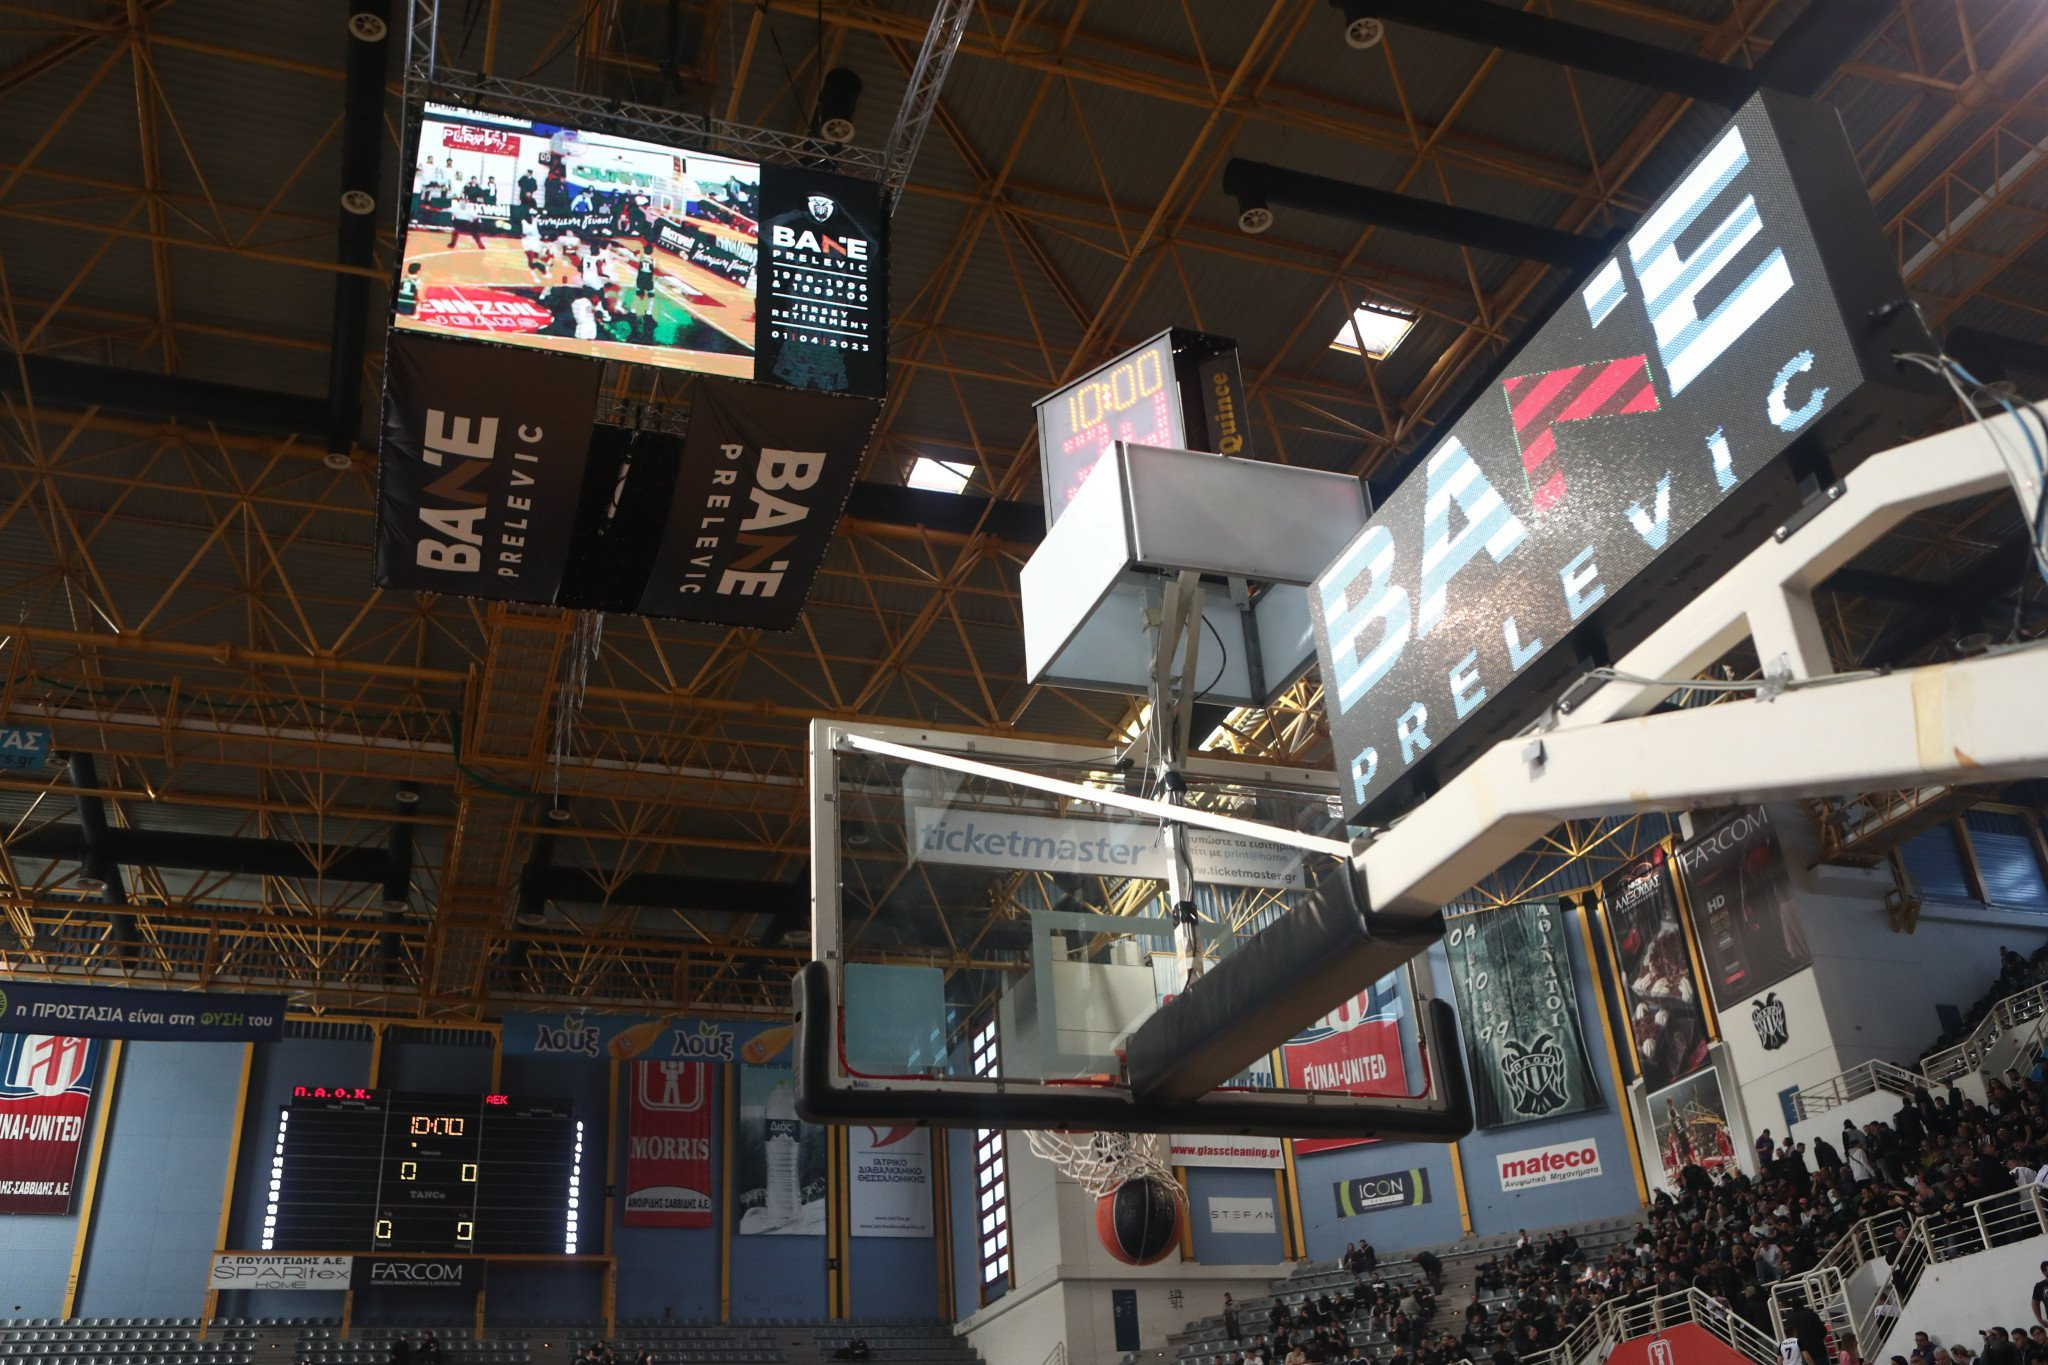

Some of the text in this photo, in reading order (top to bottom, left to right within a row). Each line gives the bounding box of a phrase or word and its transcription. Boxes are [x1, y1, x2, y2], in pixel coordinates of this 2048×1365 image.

[773, 250, 867, 273] PRELEVIC
[772, 280, 868, 302] & 1999-00
[773, 270, 867, 292] 1988-1996
[772, 309, 868, 330] RETIREMENT
[792, 303, 849, 318] JERSEY
[1069, 349, 1163, 432] 10:00
[1213, 372, 1243, 454] Quince
[498, 424, 543, 577] PRELEVIC
[679, 444, 744, 594] PRELEVIC
[1351, 350, 1830, 803] PRELEVIC
[921, 821, 1148, 866] ticketmaster
[1681, 804, 1768, 874] FARCOM
[1707, 895, 1726, 914] HD
[1450, 923, 1476, 947] 04
[1466, 971, 1488, 994] 10
[32, 1003, 124, 1023] ΠΡΟΣΤΑΣΙΑ
[128, 1010, 164, 1025] είναι
[169, 1014, 195, 1027] στη
[201, 1012, 244, 1027] ΦΥΣΗ
[248, 1016, 273, 1028] του
[1481, 1020, 1509, 1044] 99
[1303, 1053, 1387, 1090] FUNAI-UNITED
[294, 1086, 372, 1099] Π.Α.Ο.Κ.
[0, 1113, 82, 1142] NAI-UNITED
[630, 1135, 710, 1160] MORRIS
[1171, 1145, 1280, 1158] www.glasscleaning.gr
[873, 1158, 908, 1167] ΙΑΤΡΙΚΟ
[1502, 1148, 1596, 1179] mateco
[1550, 1167, 1599, 1181] Μηχανήματα
[0, 1181, 54, 1195] ΗΣ-ΣΑΒΒΙΔΗΣ
[1359, 1178, 1404, 1199] ICON
[1211, 1210, 1273, 1219] STEFAN
[221, 1256, 346, 1266] Γ. ΠΟΥΛΙΤΣΙΔΗΣ Α.Ε.
[371, 1262, 463, 1280] FARCOM
[255, 1280, 306, 1289] HOME
